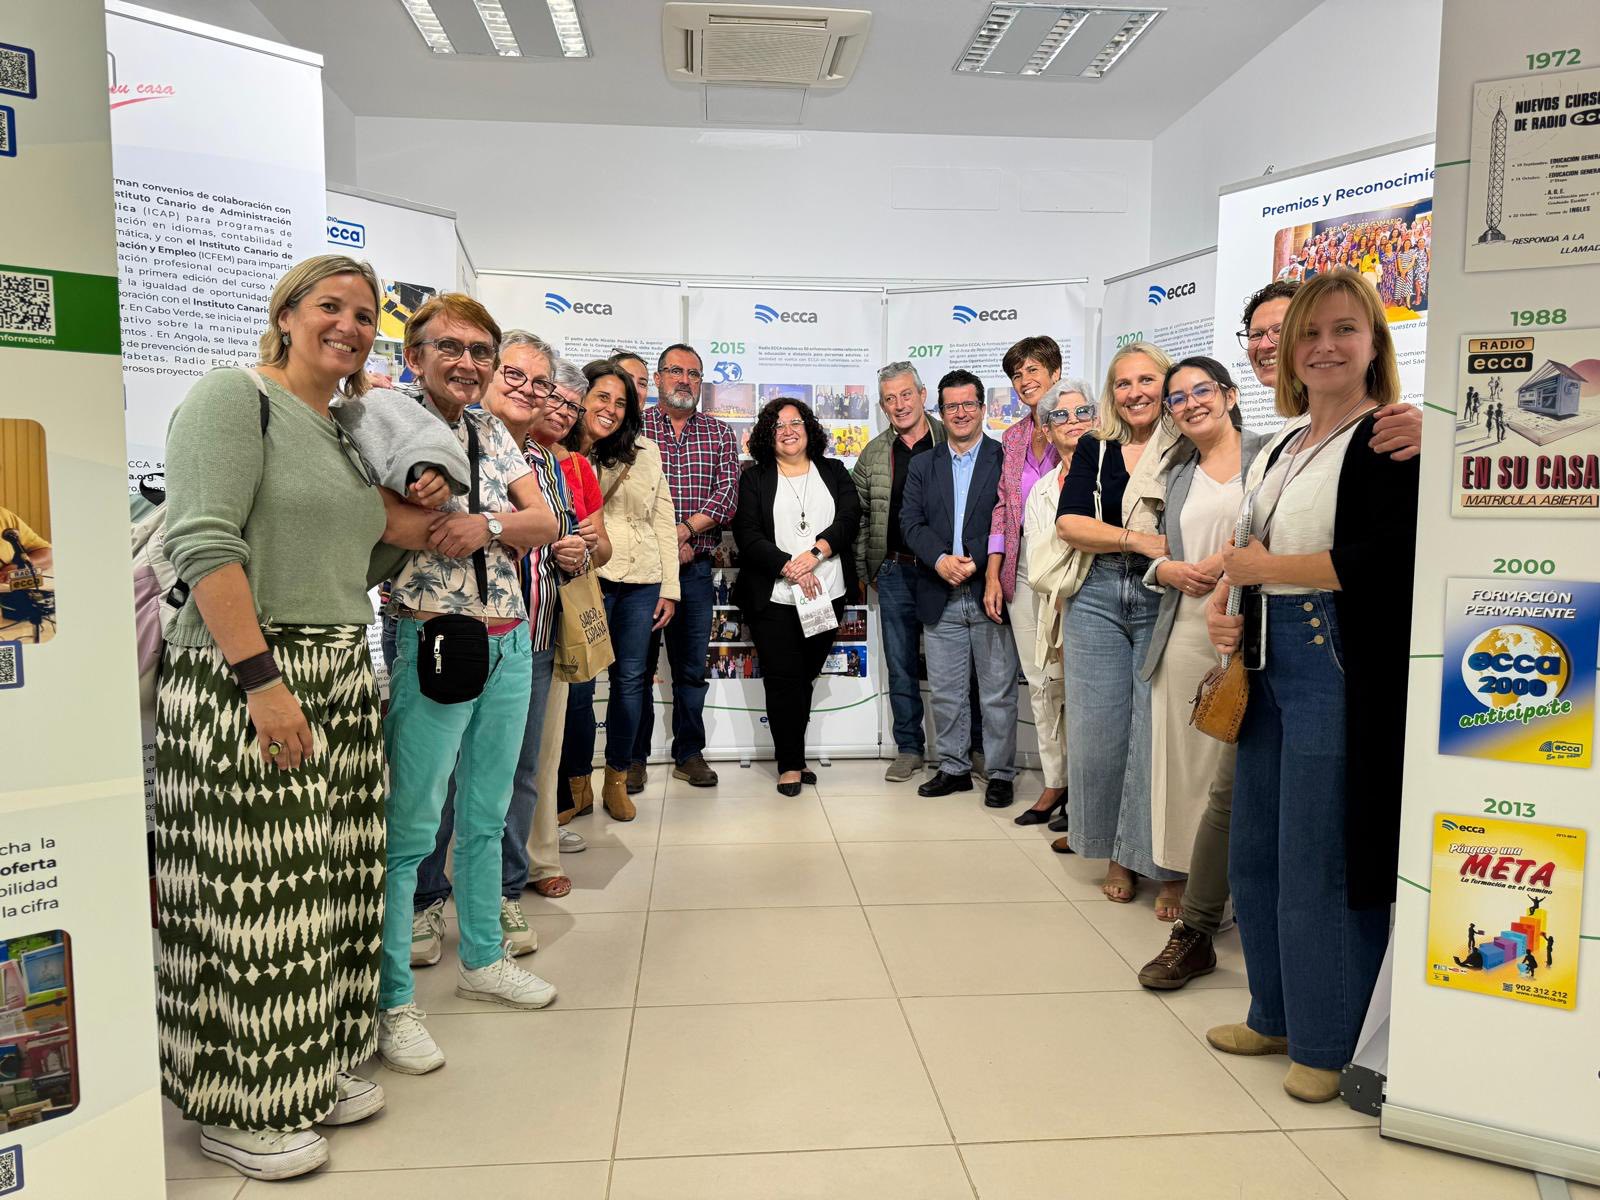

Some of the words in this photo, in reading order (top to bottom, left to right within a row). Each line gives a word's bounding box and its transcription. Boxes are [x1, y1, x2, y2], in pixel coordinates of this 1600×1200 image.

[1526, 48, 1581, 70] 1972
[137, 84, 176, 95] casa
[1515, 96, 1560, 115] NUEVOS
[1514, 118, 1528, 132] DE
[1531, 114, 1567, 130] RADIO
[1550, 156, 1580, 164] EDUCACION
[1548, 170, 1578, 178] EDUCACION
[142, 183, 194, 197] convenios
[197, 192, 209, 200] de
[212, 195, 272, 212] colaboración
[274, 206, 291, 214] con
[1262, 196, 1320, 218] Premios
[1322, 192, 1332, 206] y
[114, 190, 150, 202] stituto
[156, 196, 196, 210] Canario
[202, 204, 214, 212] de
[220, 208, 292, 226] Administración
[114, 202, 136, 212] lica
[144, 206, 180, 220] (ICAP)
[186, 215, 210, 224] para
[217, 220, 274, 234] programas
[280, 229, 292, 237] de
[116, 216, 146, 226] ación
[152, 222, 166, 230] en
[172, 222, 216, 238] idiomas,
[221, 232, 282, 247] contabilidad
[327, 225, 360, 242] cca
[1512, 235, 1560, 245] RESPONDA
[1572, 233, 1585, 241] LA
[155, 234, 161, 242] y
[164, 235, 182, 244] con
[200, 240, 240, 252] Instituto
[244, 246, 278, 258] Canario
[150, 246, 156, 254] y
[158, 246, 196, 258] Empleo
[199, 250, 234, 264] (ICFEM)
[237, 258, 256, 266] para
[118, 254, 148, 263] ación
[154, 258, 212, 272] profesional
[217, 266, 278, 280] ocupacional.
[125, 266, 134, 274] la
[139, 268, 178, 279] primera
[182, 274, 218, 284] edición
[222, 278, 236, 286] del
[240, 281, 266, 290] curso
[128, 278, 136, 286] la
[142, 279, 186, 292] igualdad
[192, 286, 204, 294] de
[210, 288, 271, 302] oportunidade
[1167, 282, 1196, 300] ecca
[194, 298, 234, 310] Instituto
[573, 301, 613, 316] ecca
[130, 304, 142, 312] En
[145, 305, 170, 315] Cabo
[172, 308, 204, 320] Verde,
[218, 312, 242, 322] inicia
[780, 310, 818, 324] ecca
[978, 308, 1018, 322] ecca
[1510, 308, 1567, 326] 1988
[120, 316, 152, 326] ativo
[157, 320, 188, 328] sobre
[194, 322, 203, 330] la
[120, 328, 146, 336] entos
[157, 330, 170, 338] En
[174, 332, 210, 344] Angola,
[228, 336, 248, 346] lleva
[1116, 331, 1144, 349] 2020
[1480, 339, 1525, 351] RADIO
[141, 342, 196, 353] prevención
[211, 347, 236, 356] salud
[710, 342, 746, 354] 2015
[908, 344, 944, 358] 2017
[122, 351, 168, 363] fabetas.
[174, 356, 206, 366] Radio
[212, 358, 240, 368] ECCA
[1474, 355, 1527, 370] ecca
[122, 365, 154, 374] erosos
[156, 366, 204, 376] proyectos
[128, 460, 150, 469] CCA
[1462, 456, 1492, 490] EN
[1497, 456, 1530, 490] SU
[1536, 455, 1600, 490] CASA
[1465, 495, 1536, 506] MATRICULA
[1540, 494, 1593, 506] ABIERTA
[1492, 558, 1556, 574] 2000
[1472, 589, 1572, 604] FORMACIÓN
[579, 608, 599, 628] SABOR
[1464, 604, 1576, 618] PERMANENTE
[1468, 652, 1561, 676] ecca
[1478, 676, 1548, 697] 2000
[1484, 798, 1536, 818] 2013
[1459, 824, 1485, 834] ecca
[41, 837, 56, 850] la
[1450, 844, 1497, 856] Póngase
[1500, 846, 1522, 856] una
[0, 859, 56, 876] oferta
[1460, 854, 1556, 888] META
[1471, 878, 1506, 889] formación
[1526, 887, 1552, 895] camino
[2, 906, 16, 918] la
[21, 898, 59, 914] cifra
[1516, 984, 1531, 992] 902
[1534, 986, 1550, 996] 312
[1552, 990, 1568, 998] 212
